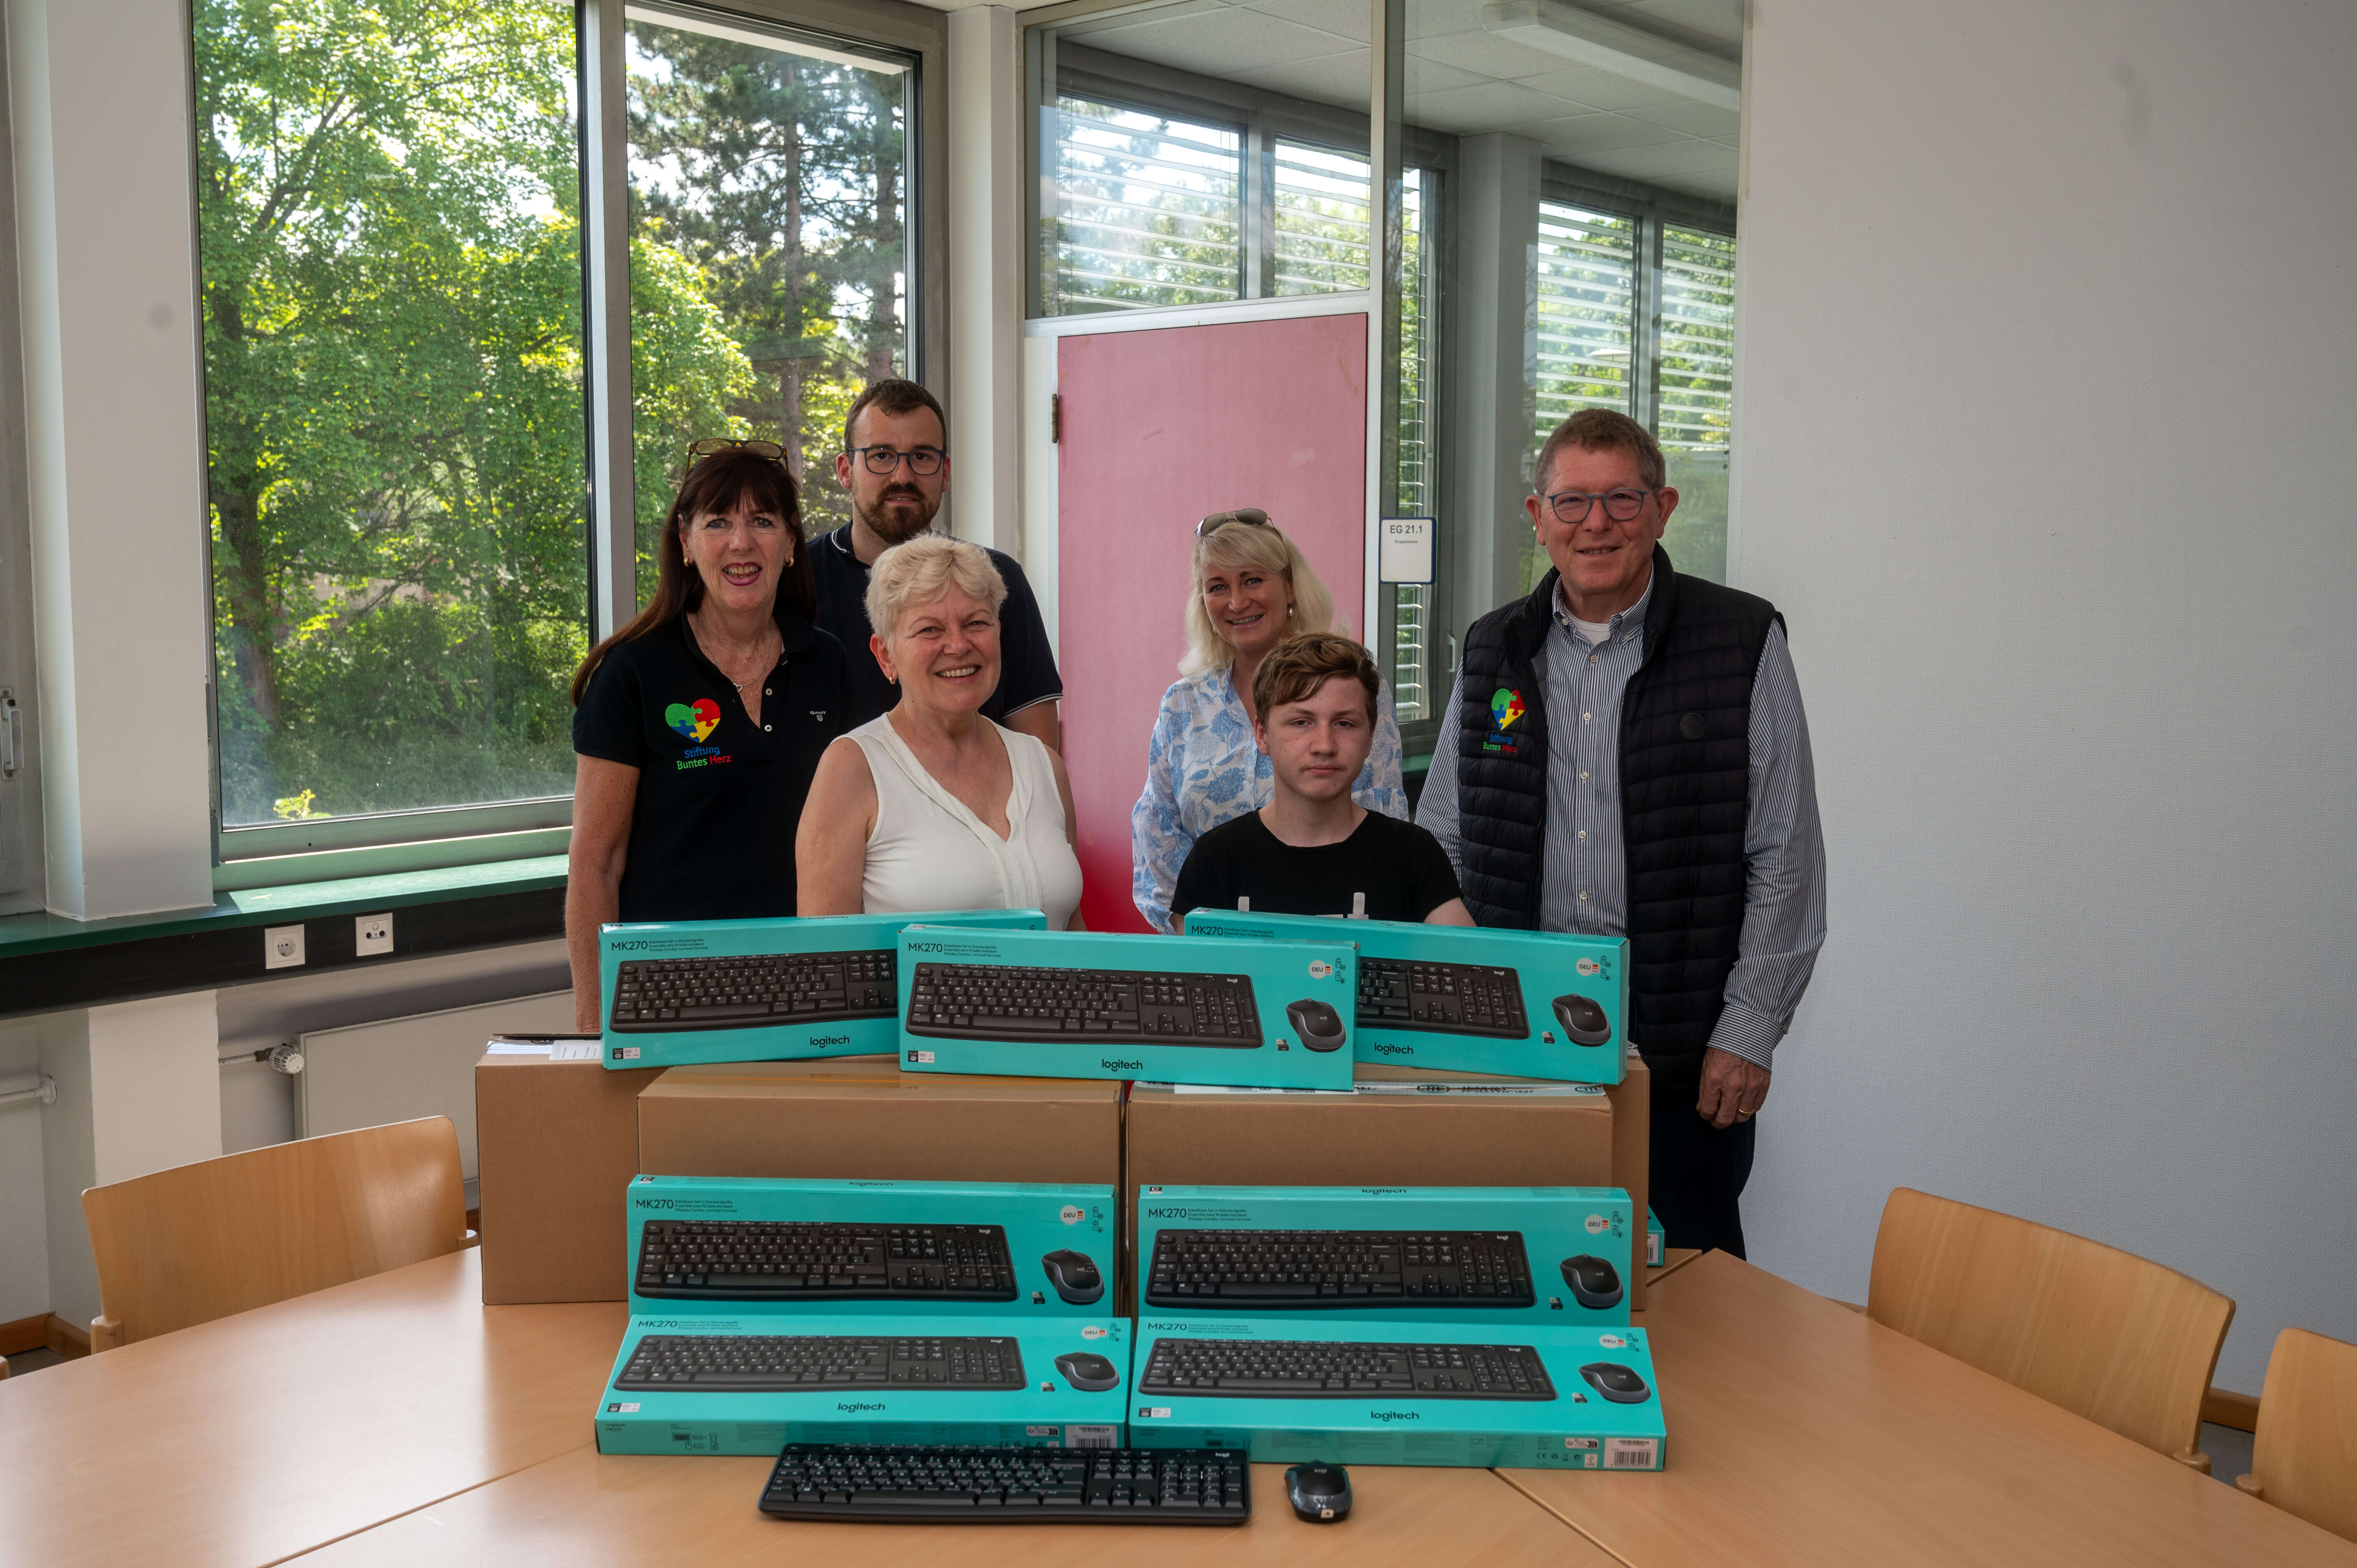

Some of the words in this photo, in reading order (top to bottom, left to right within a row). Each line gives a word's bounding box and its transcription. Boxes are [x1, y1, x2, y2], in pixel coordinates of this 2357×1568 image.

[1390, 525, 1403, 533] EG
[1405, 525, 1422, 533] 21.1
[1489, 733, 1512, 744] Stiftung
[684, 746, 720, 758] Stiftung
[1483, 742, 1501, 751] Buntes
[1502, 744, 1517, 753] Herz
[677, 758, 707, 770] Buntes
[709, 754, 732, 765] Herz
[1191, 925, 1223, 936] MK270
[611, 941, 648, 951] MK270
[908, 942, 943, 952] MK270
[810, 1035, 850, 1048] logitech
[1374, 1042, 1413, 1055] logitech
[1102, 1059, 1143, 1072] logitech
[636, 1199, 674, 1209] MK270
[1148, 1208, 1186, 1218] MK270
[838, 1403, 885, 1413] logitech
[1371, 1411, 1419, 1422] logitech
